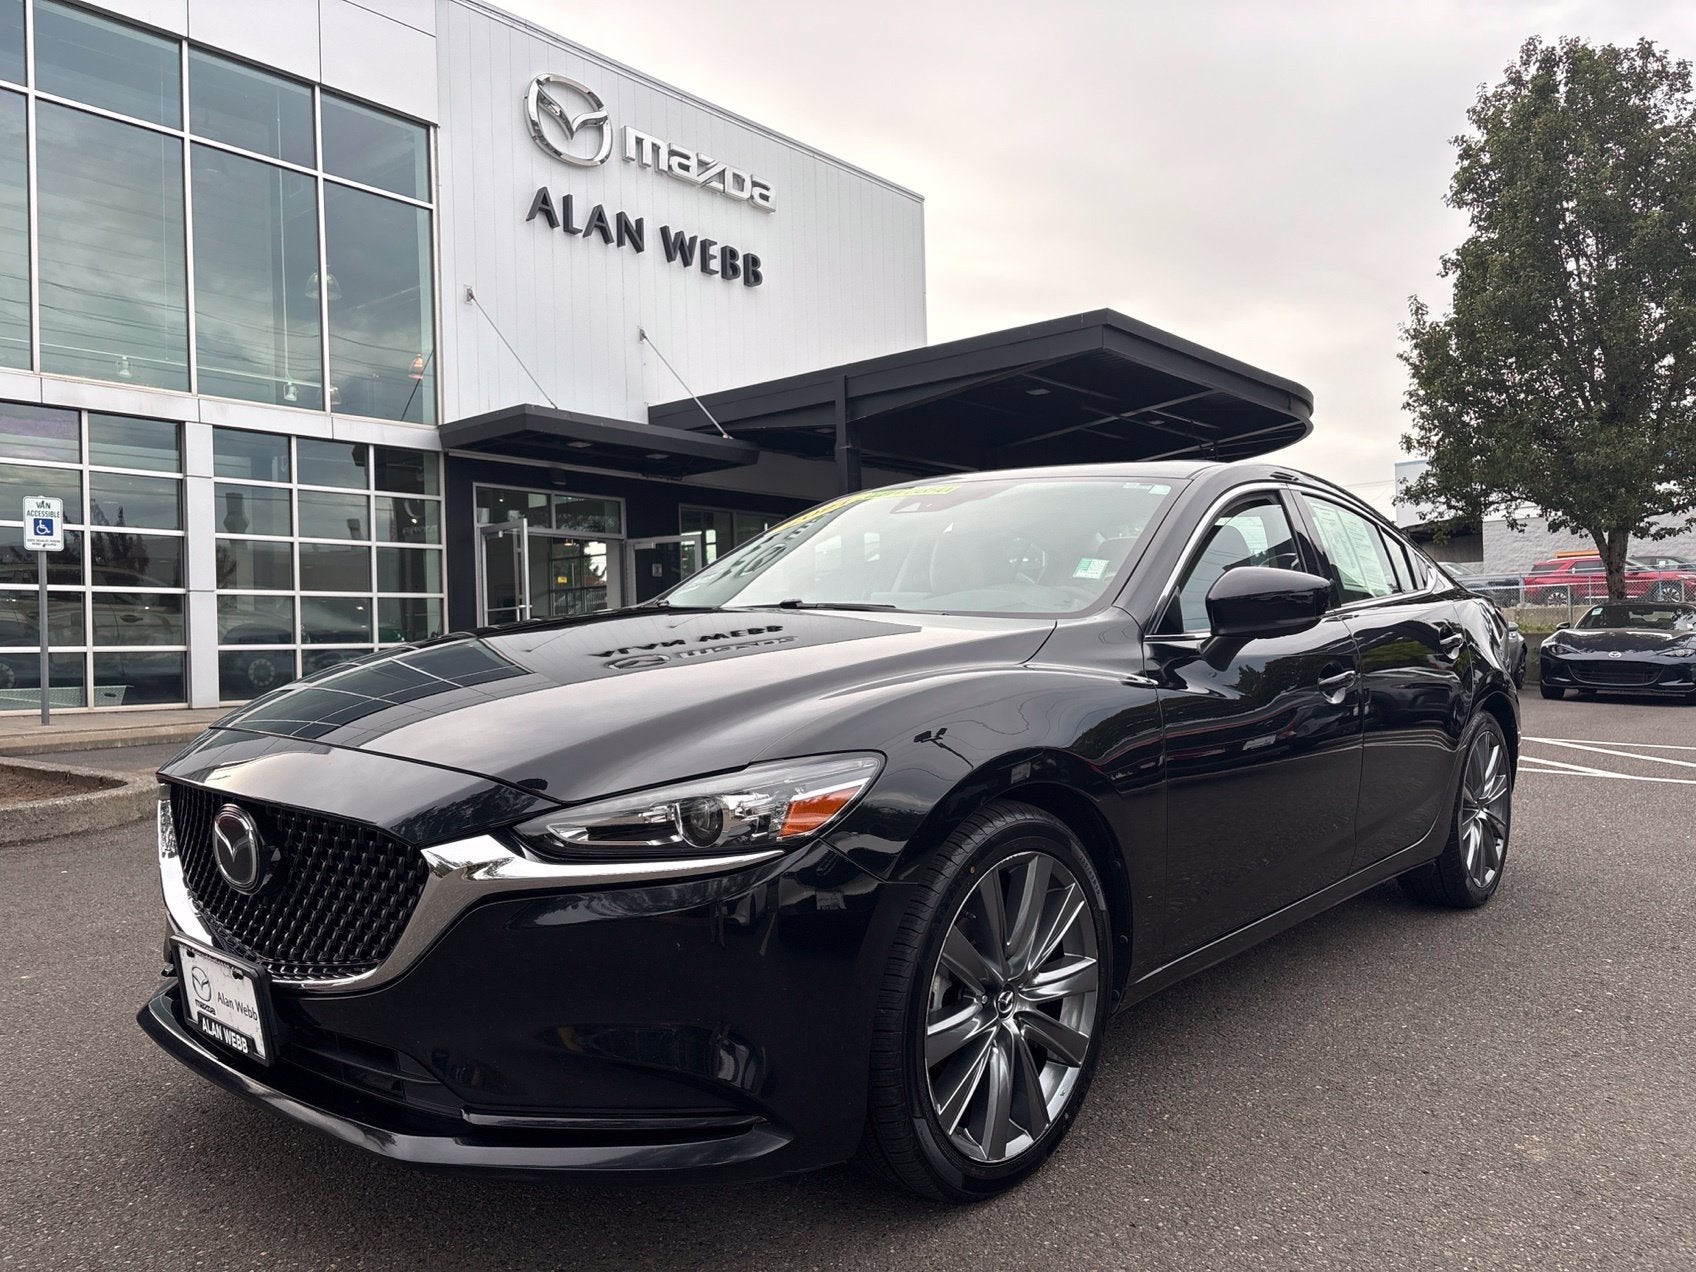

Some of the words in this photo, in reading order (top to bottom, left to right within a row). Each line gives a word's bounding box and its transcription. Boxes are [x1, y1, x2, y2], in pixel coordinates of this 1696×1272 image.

[620, 124, 776, 213] mazda
[525, 186, 645, 254] ALAN
[659, 225, 763, 287] WEBB
[27, 510, 59, 518] ACCESSIBLE
[36, 501, 51, 509] VAN
[217, 991, 235, 1009] Alan
[235, 1000, 258, 1020] Webb
[202, 1017, 223, 1040] ALAN
[223, 1027, 248, 1053] WEBB
